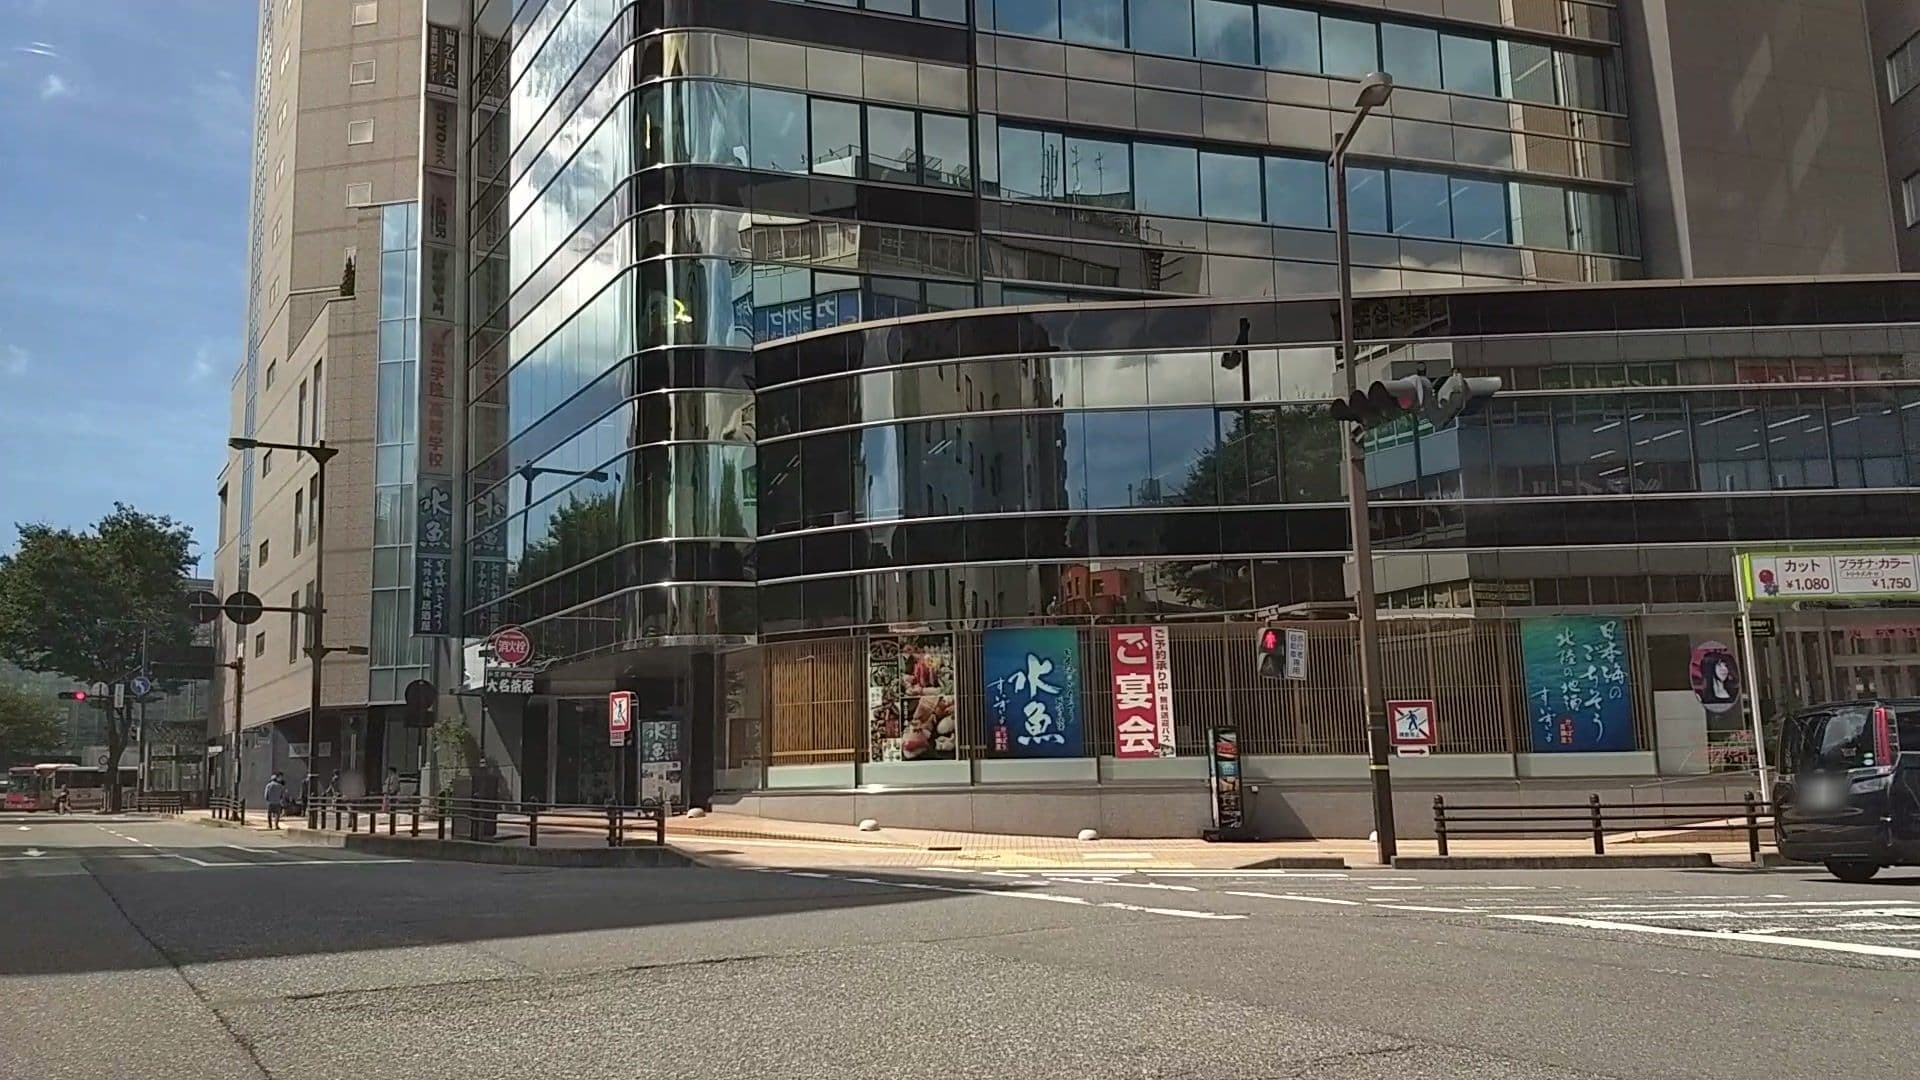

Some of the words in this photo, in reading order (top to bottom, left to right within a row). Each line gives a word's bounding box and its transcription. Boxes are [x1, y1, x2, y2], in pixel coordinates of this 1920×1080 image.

[419, 486, 451, 549] 水魚
[1784, 559, 1821, 572] カット
[1786, 577, 1831, 591] ¥1,080
[1872, 577, 1912, 589] ¥1,750
[498, 640, 527, 654] 消火栓
[1154, 628, 1169, 693] ご予約承り中
[1555, 627, 1583, 712] 北陸の地酒
[1599, 620, 1628, 699] 日本海の
[1008, 651, 1065, 747] 水魚
[1115, 632, 1156, 754] ご宴会
[1579, 644, 1605, 742] ごちそう
